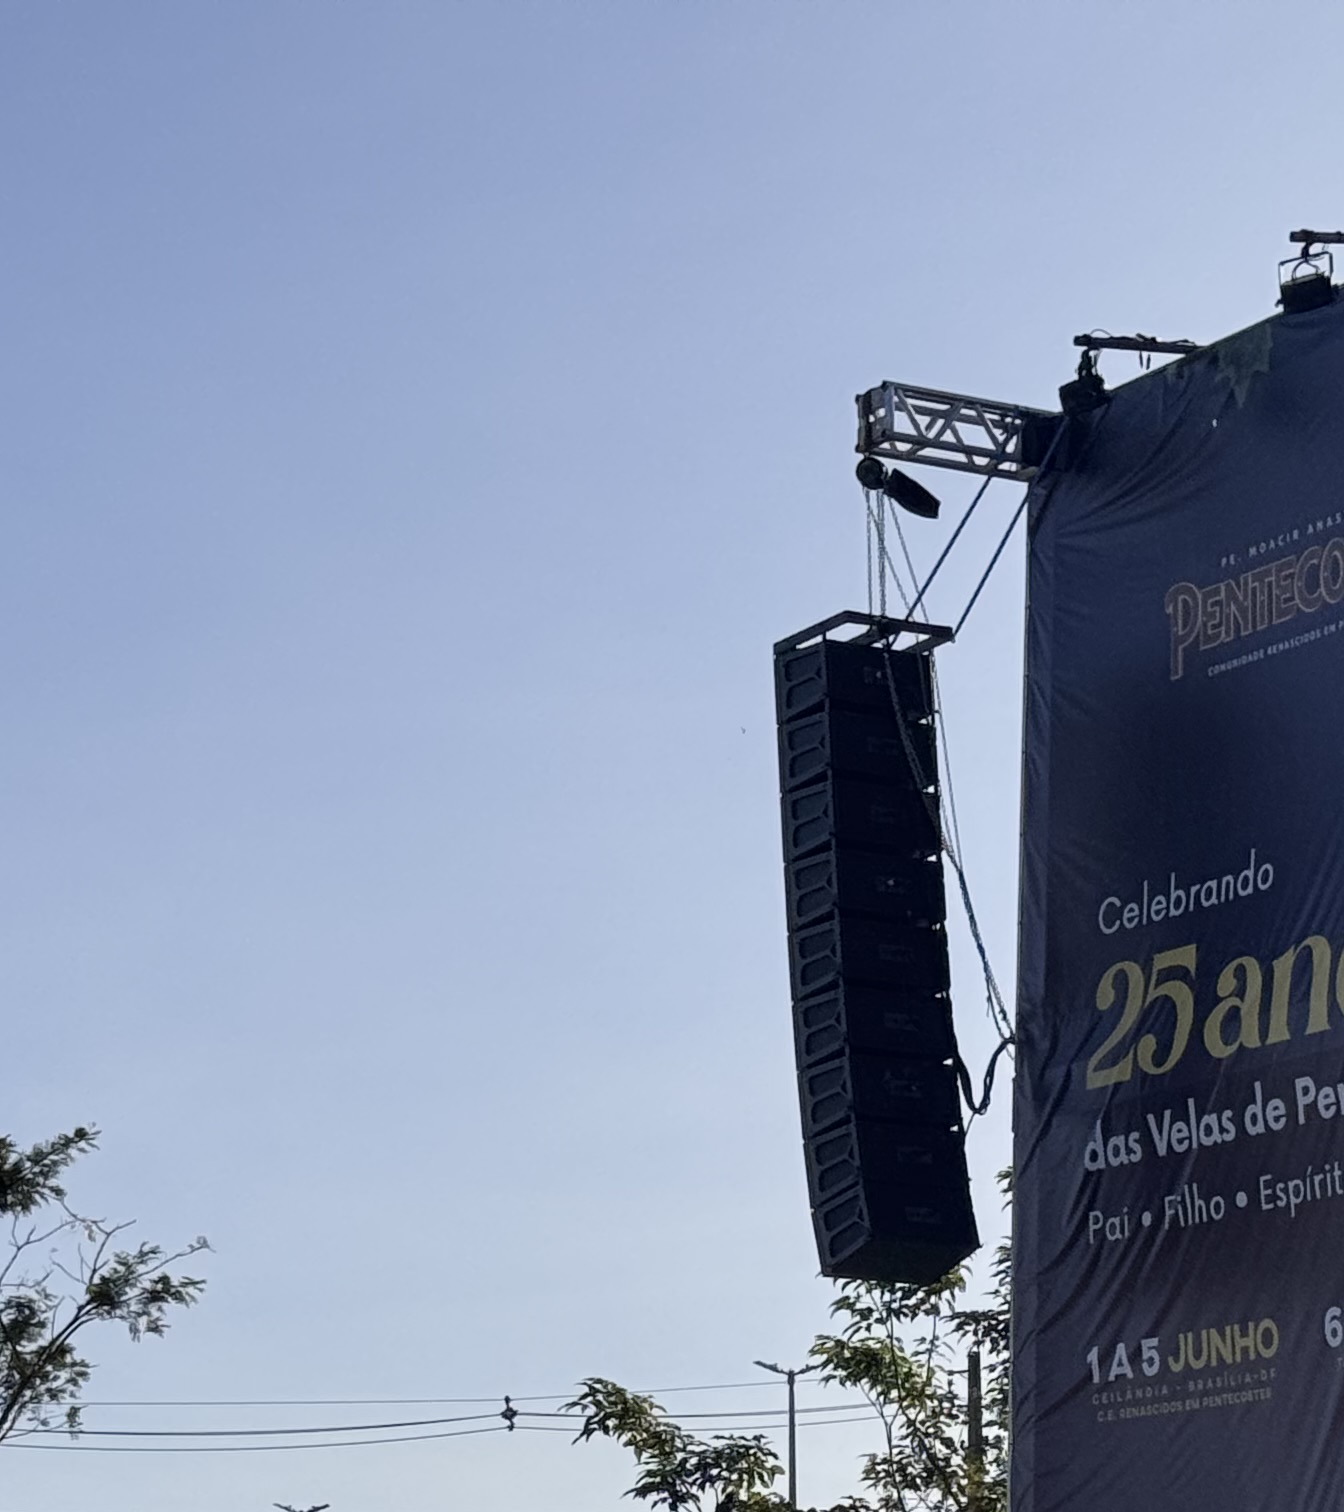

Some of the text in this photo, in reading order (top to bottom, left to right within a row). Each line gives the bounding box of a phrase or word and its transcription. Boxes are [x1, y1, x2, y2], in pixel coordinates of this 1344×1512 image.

[1248, 529, 1300, 558] MOACIR
[1207, 648, 1265, 677] COMUNIDADE
[1098, 848, 1274, 934] Celebrando
[1086, 943, 1197, 1090] 25
[1084, 1119, 1142, 1172] das
[1147, 1097, 1236, 1158] Velas
[1244, 1081, 1287, 1135] de
[1088, 1207, 1130, 1245] Pai
[1164, 1183, 1225, 1230] Filho
[1168, 1318, 1279, 1372] JUNHO
